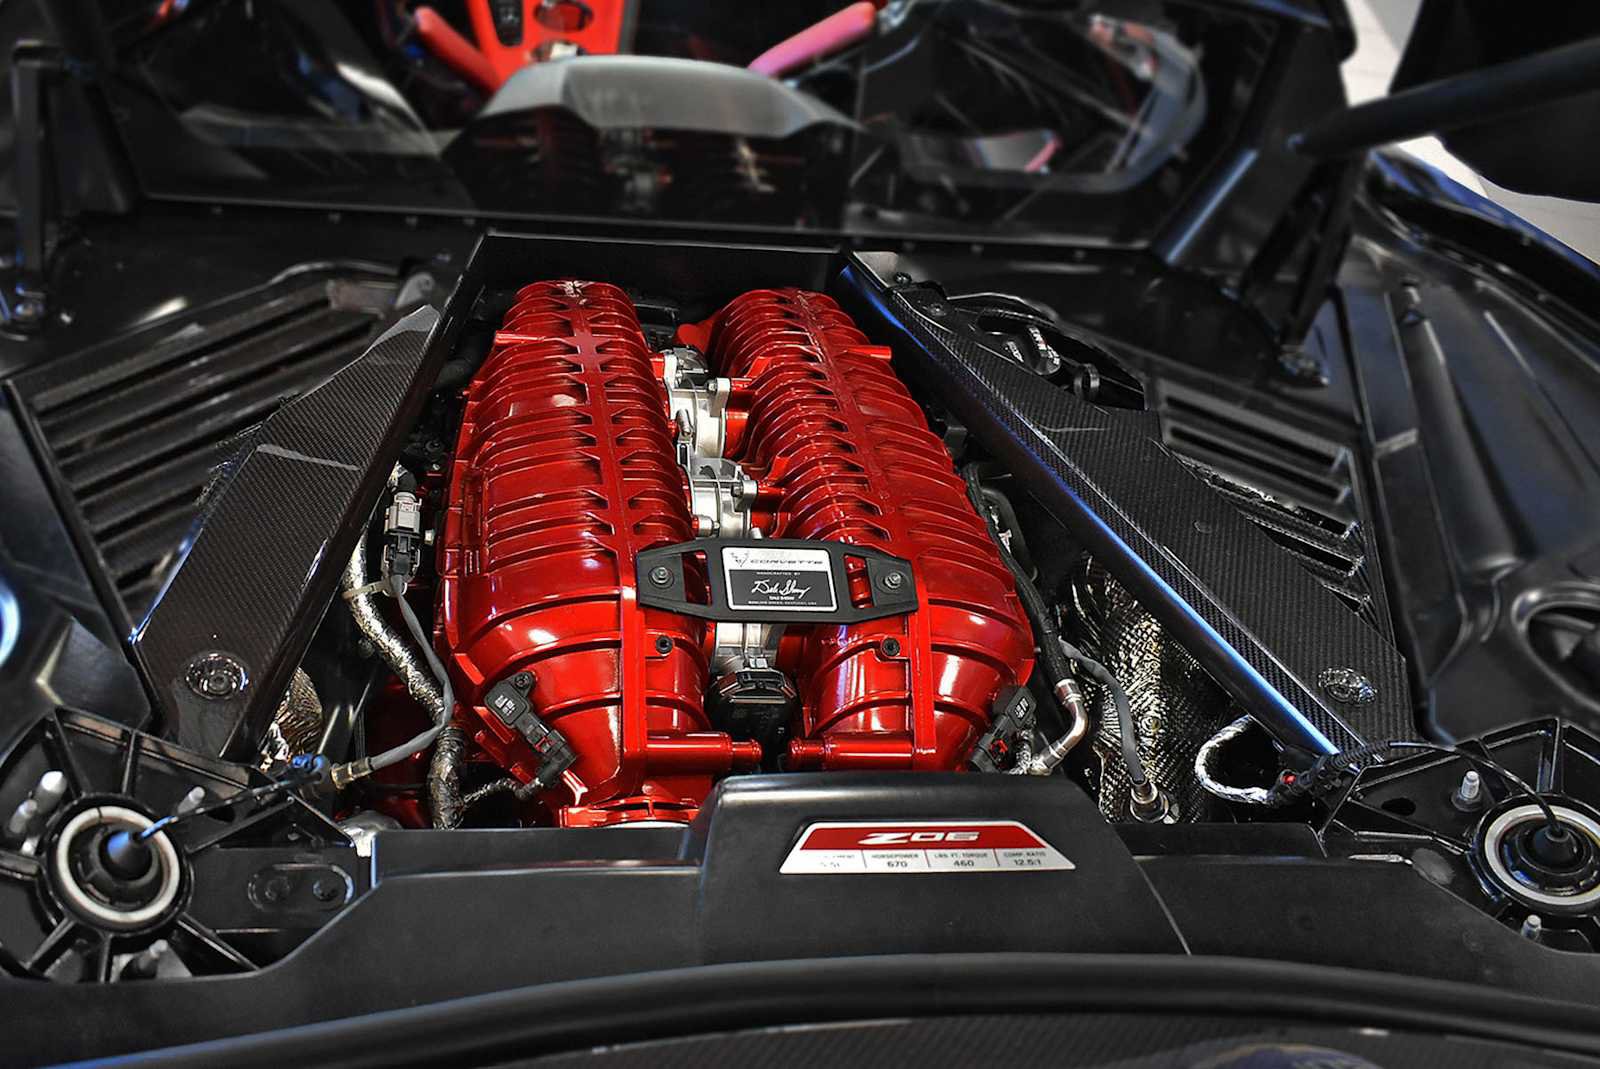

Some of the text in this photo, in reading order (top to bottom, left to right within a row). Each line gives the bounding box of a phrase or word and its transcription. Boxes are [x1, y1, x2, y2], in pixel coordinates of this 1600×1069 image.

[857, 831, 980, 845] Z06
[887, 860, 909, 868] 670
[953, 859, 975, 867] 460
